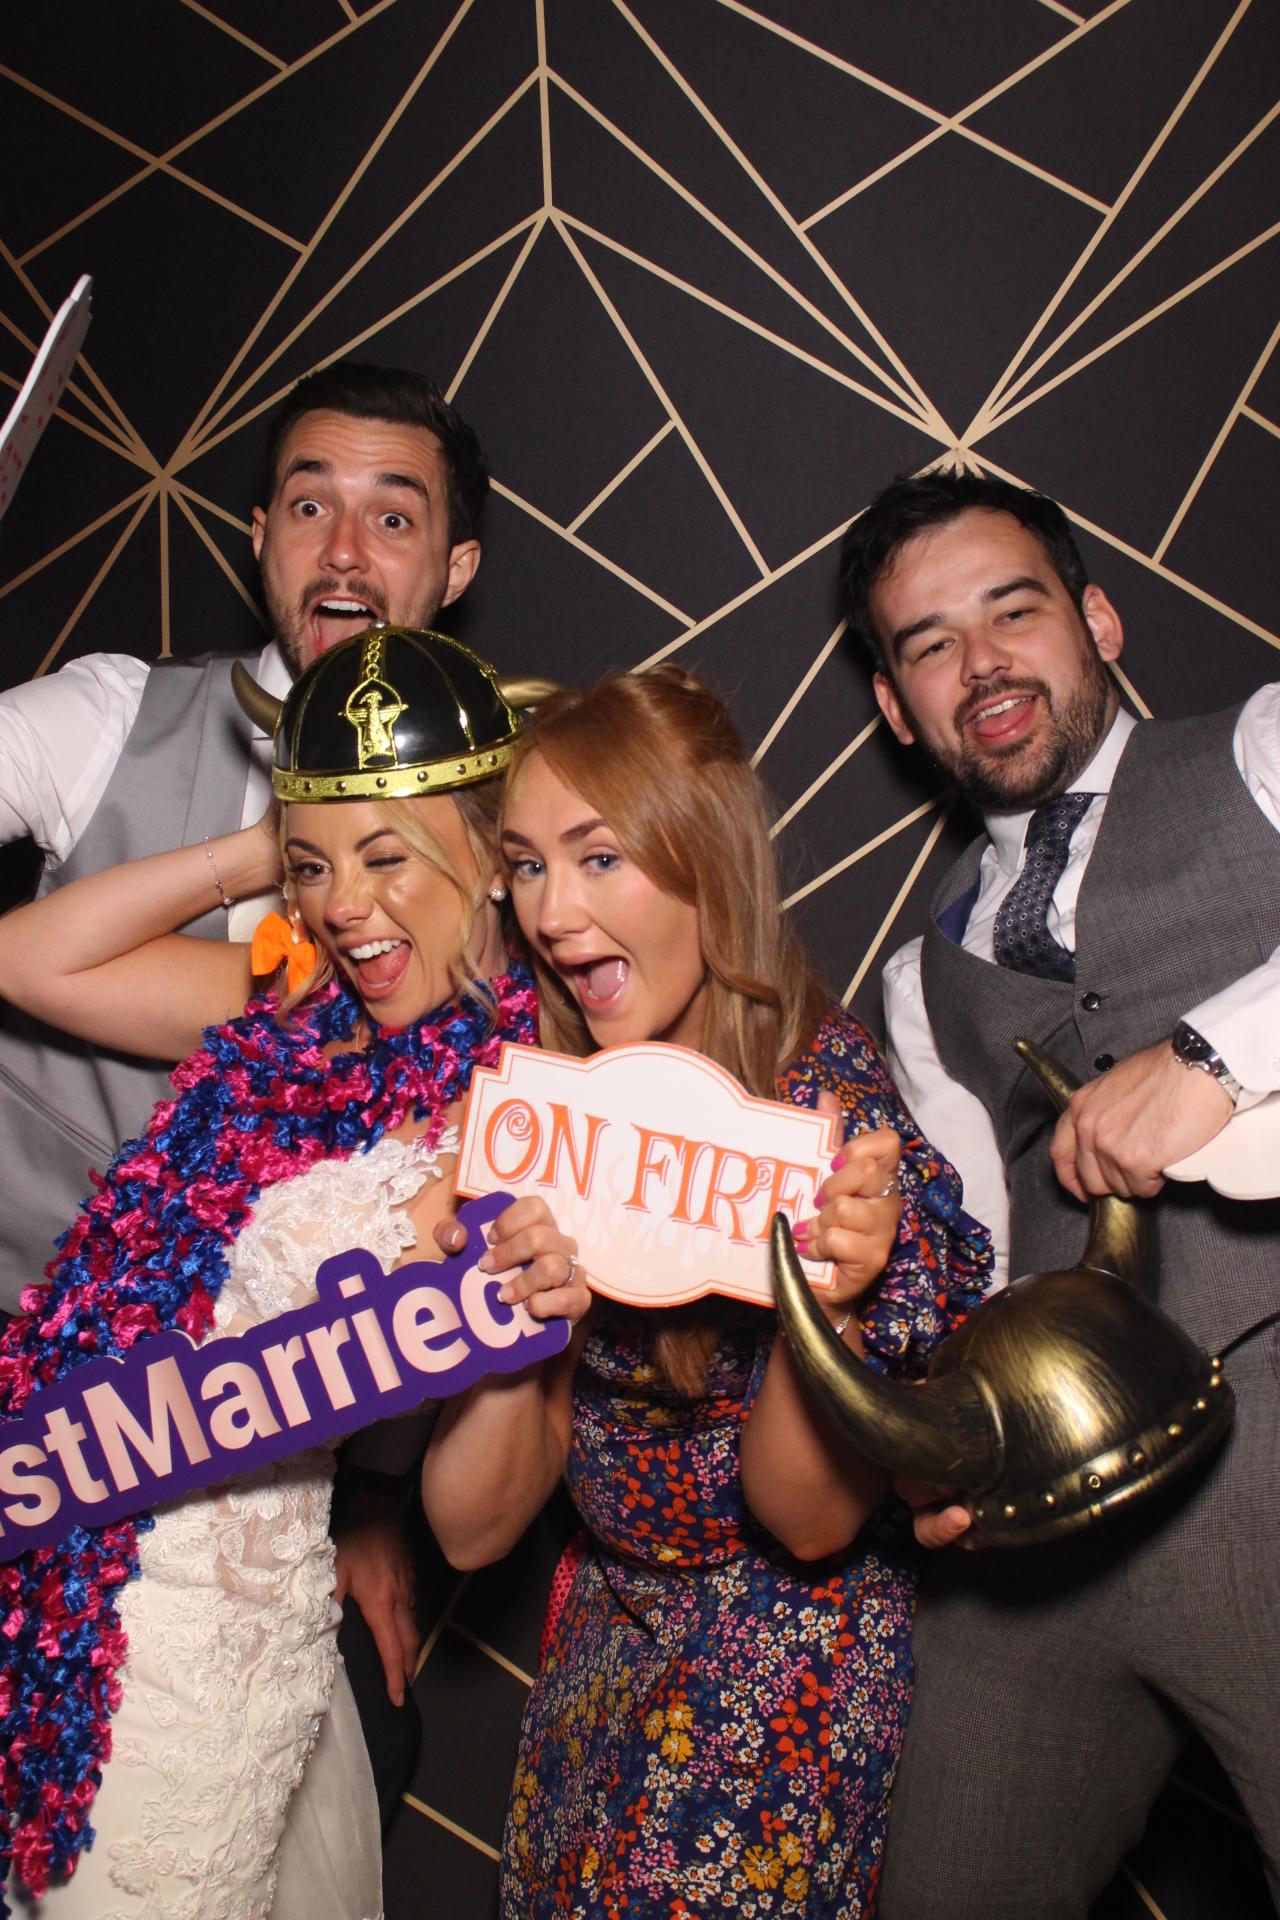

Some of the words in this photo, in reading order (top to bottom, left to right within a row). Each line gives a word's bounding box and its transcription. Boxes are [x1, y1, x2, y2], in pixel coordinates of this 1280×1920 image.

[484, 1098, 612, 1200] ON
[622, 1122, 821, 1247] FIRE
[0, 1220, 547, 1537] stMarried
